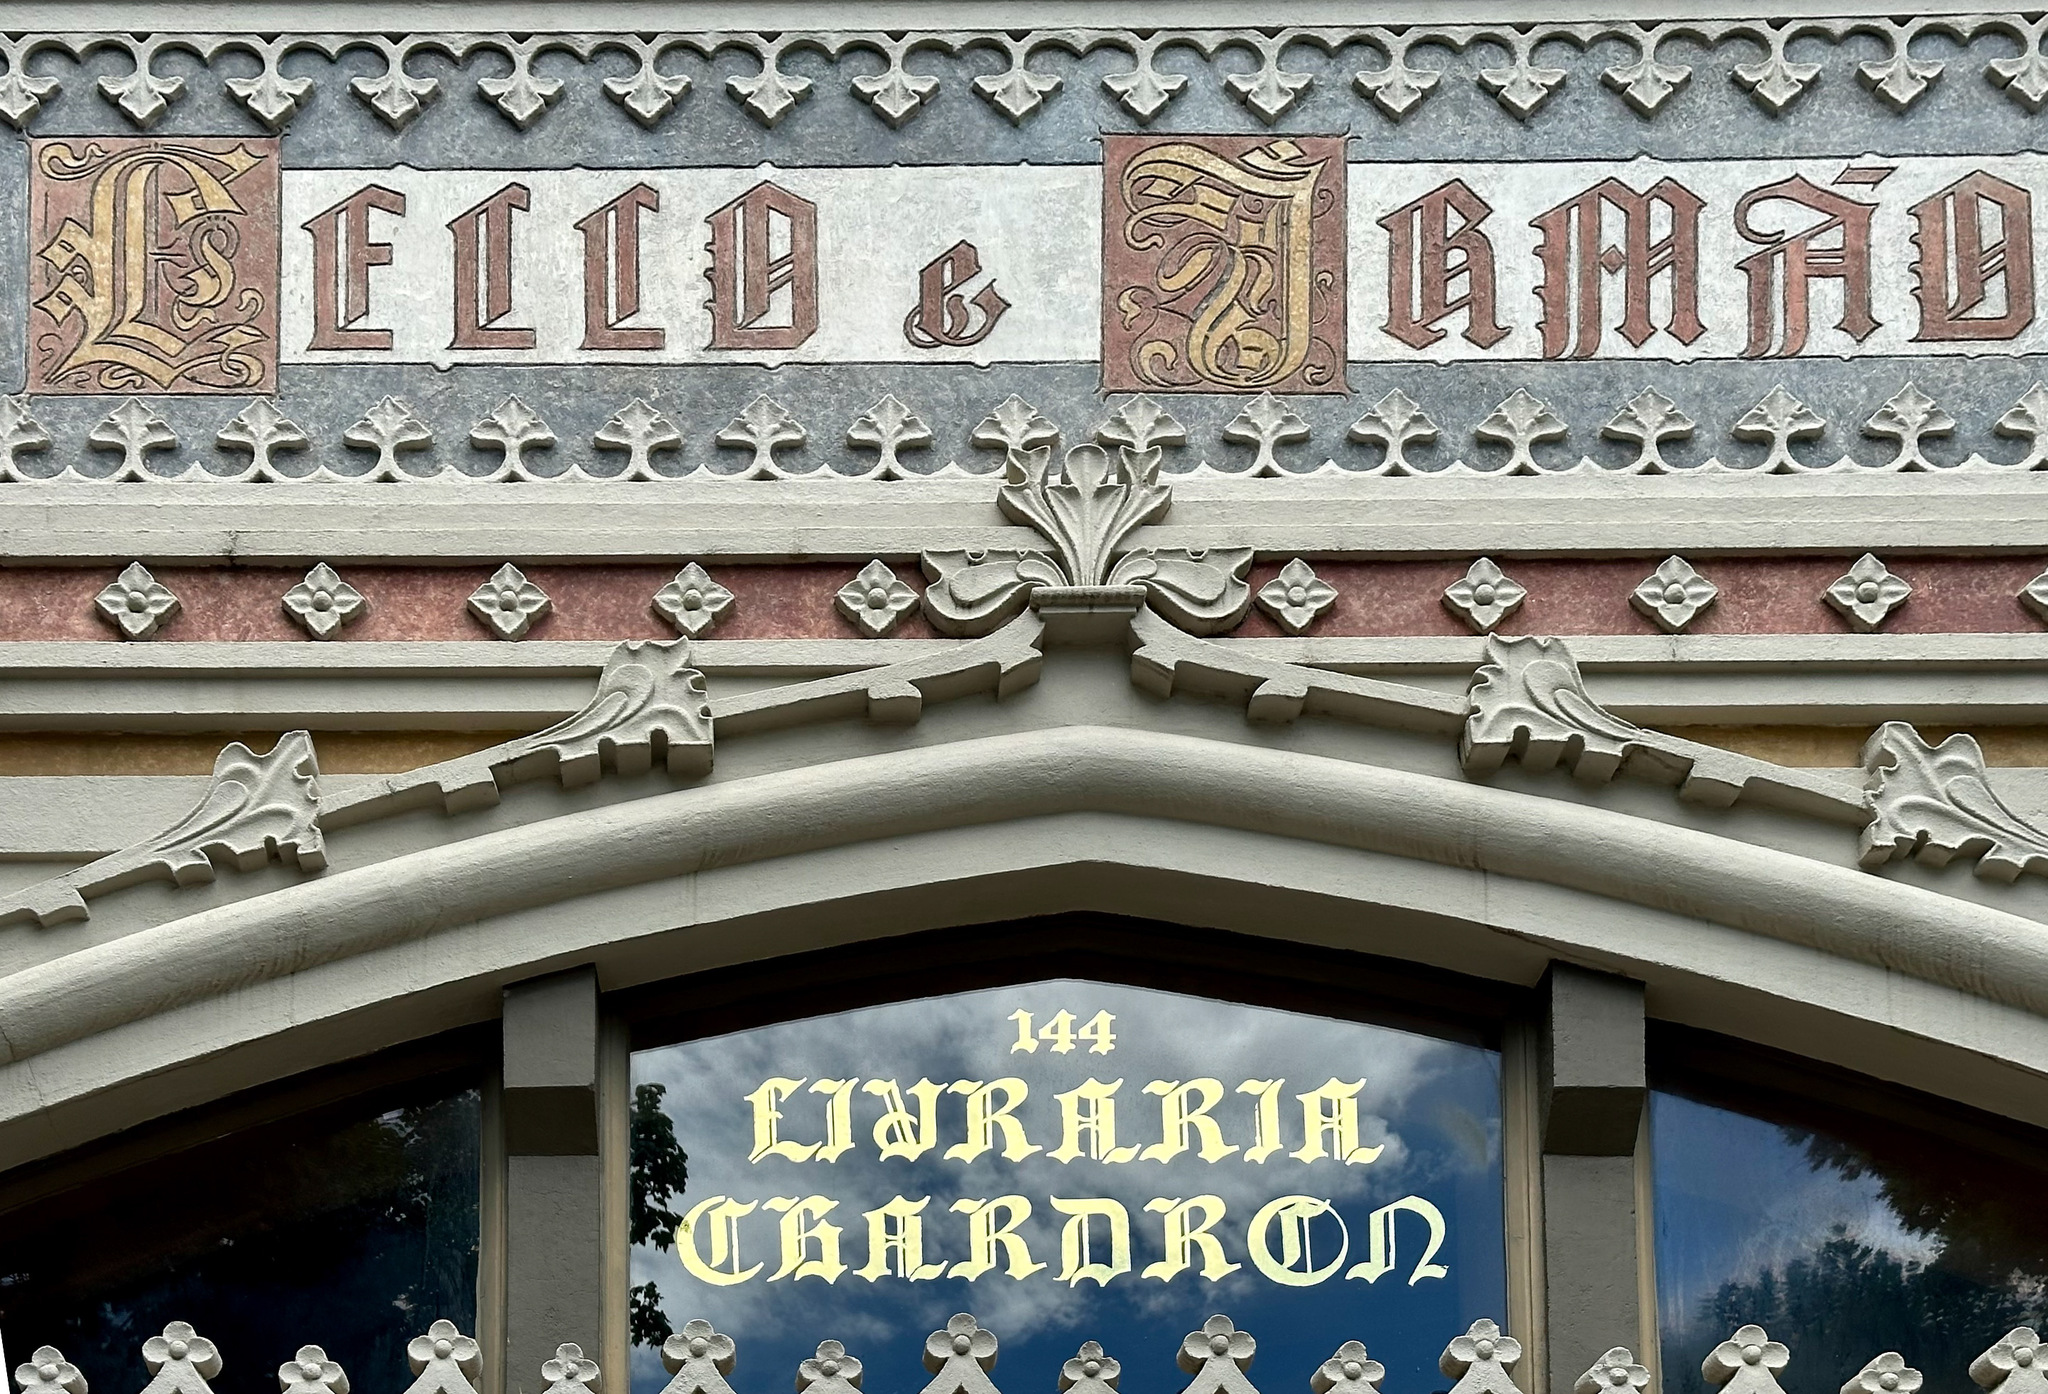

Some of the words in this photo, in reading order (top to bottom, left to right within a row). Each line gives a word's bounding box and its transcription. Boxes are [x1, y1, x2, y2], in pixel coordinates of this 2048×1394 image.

[34, 142, 817, 390] LELLO
[903, 239, 1012, 349] &
[1008, 1008, 1117, 1056] 144
[744, 1076, 1385, 1166] LIVRARIA
[676, 1194, 1449, 1287] CHARDRON
